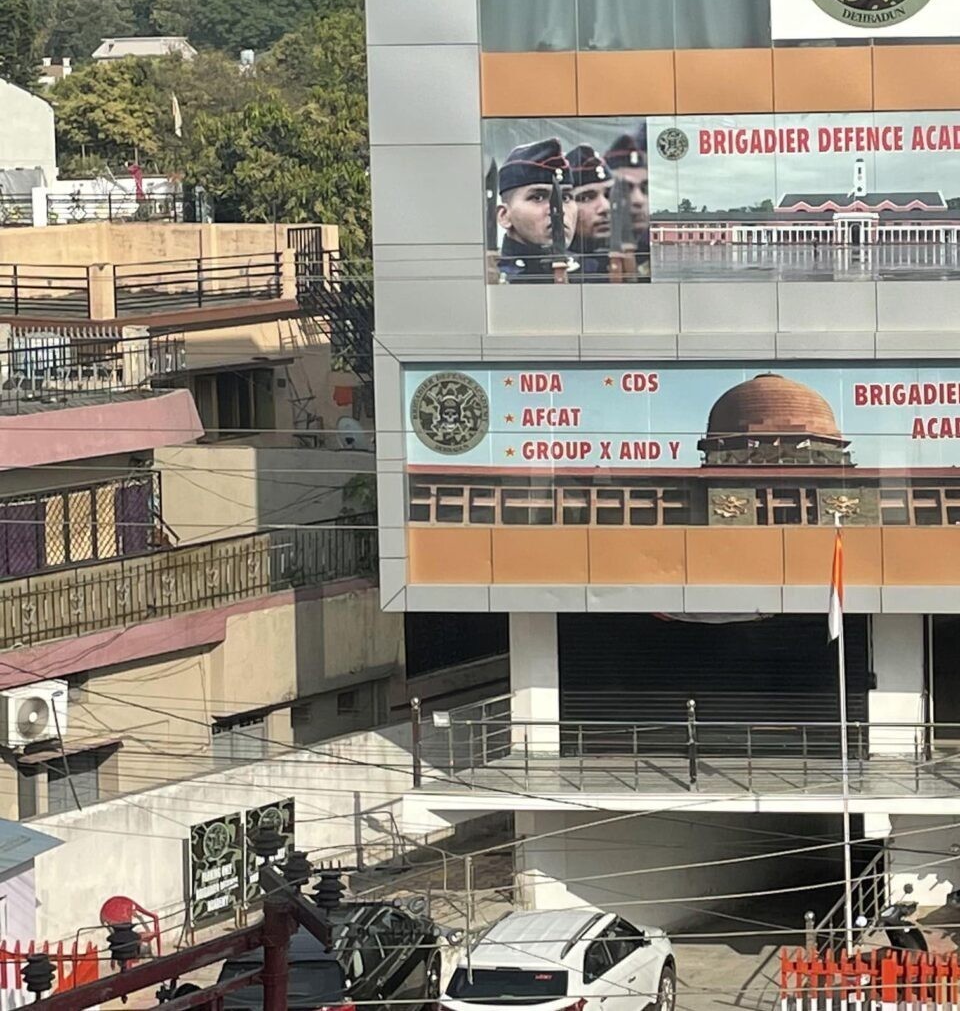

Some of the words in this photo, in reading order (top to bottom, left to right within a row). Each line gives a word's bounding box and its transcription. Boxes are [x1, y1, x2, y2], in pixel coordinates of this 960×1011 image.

[841, 6, 906, 24] DEHRADUN
[699, 127, 810, 155] BRIGADIER
[818, 126, 903, 153] DEFENCE
[519, 373, 562, 392] NDA
[621, 373, 658, 392] CDS
[521, 408, 581, 427] AFCAT
[521, 441, 592, 460] GROUP
[600, 442, 611, 460] X
[619, 442, 661, 460] AND
[669, 442, 680, 459] Y
